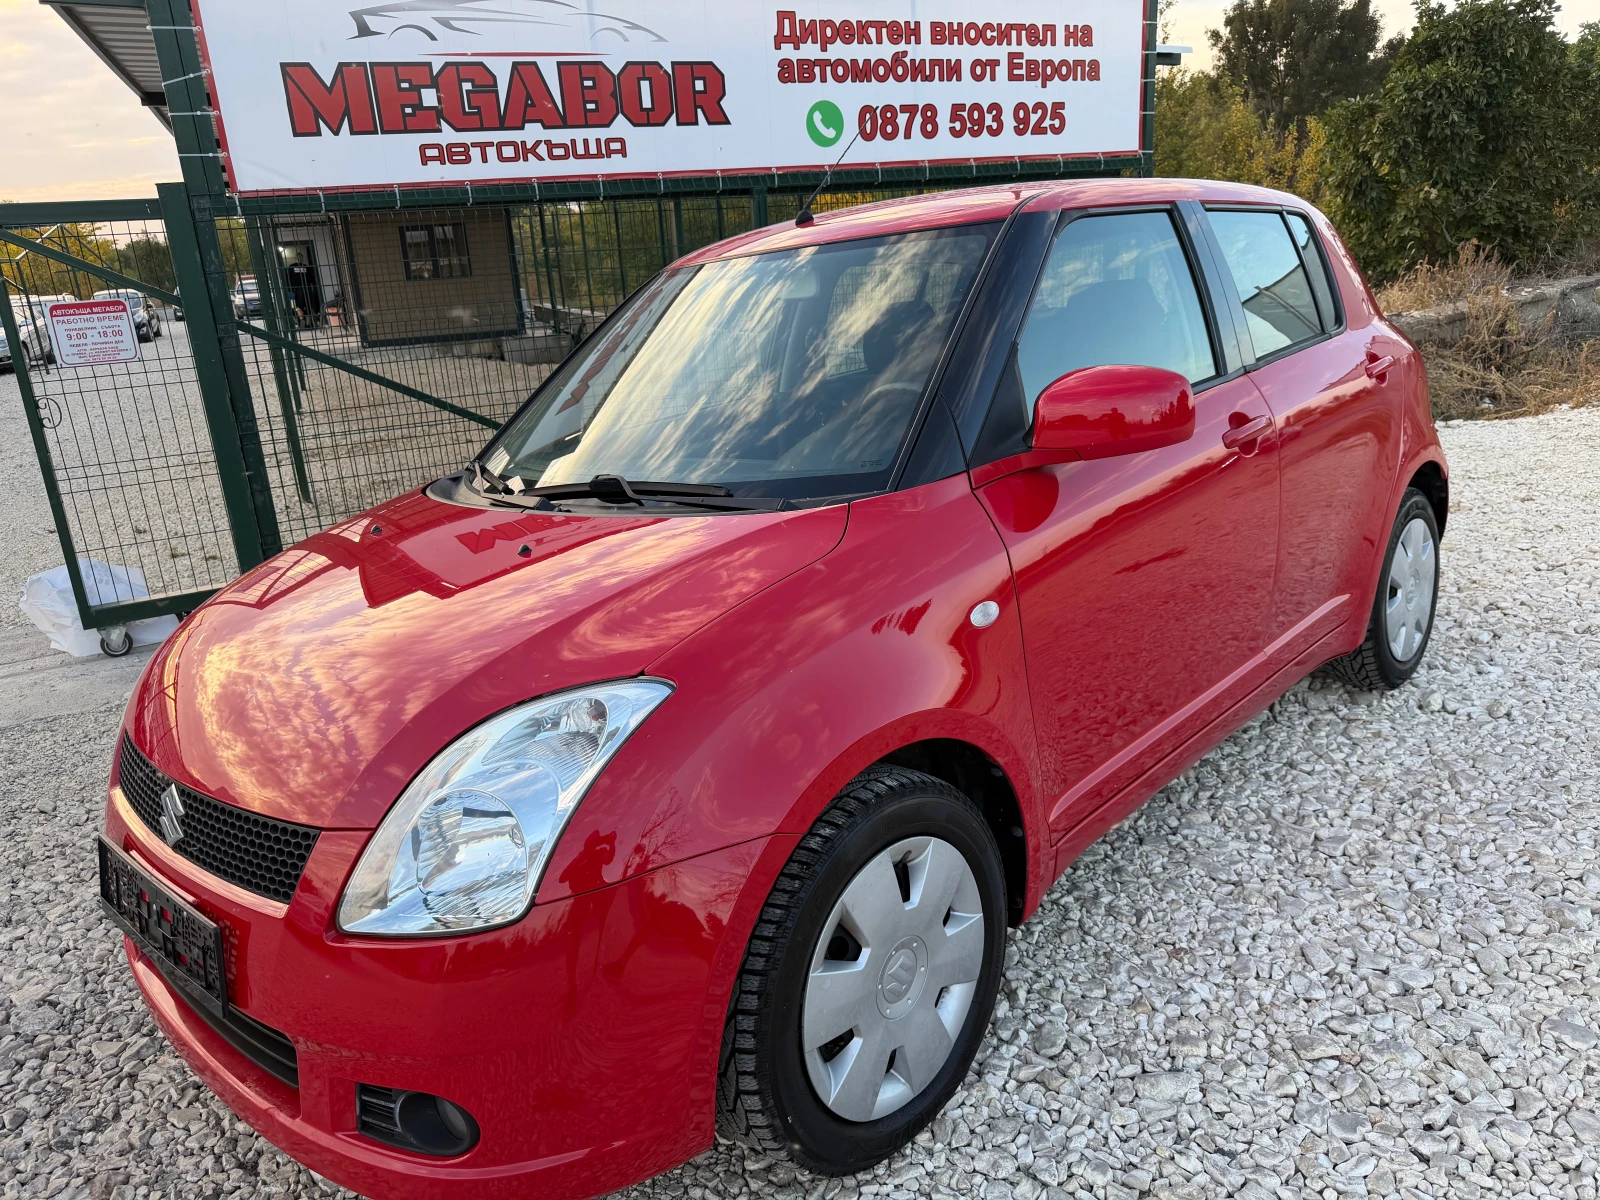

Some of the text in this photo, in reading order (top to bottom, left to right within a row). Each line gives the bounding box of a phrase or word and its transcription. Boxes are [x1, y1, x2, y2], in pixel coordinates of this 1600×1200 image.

[774, 10, 1093, 52] Директен вносител на
[777, 51, 1101, 88] автомобили от Европа
[280, 61, 732, 138] MEGABOR
[858, 101, 1066, 142] 0878 593 925
[419, 137, 627, 166] АВТОКЪЩА
[53, 305, 124, 316] АВТОКЪЩА МЕГАБОР
[56, 317, 95, 325] РАБОТНО
[66, 332, 88, 341] 9:00
[97, 329, 123, 338] 18:00
